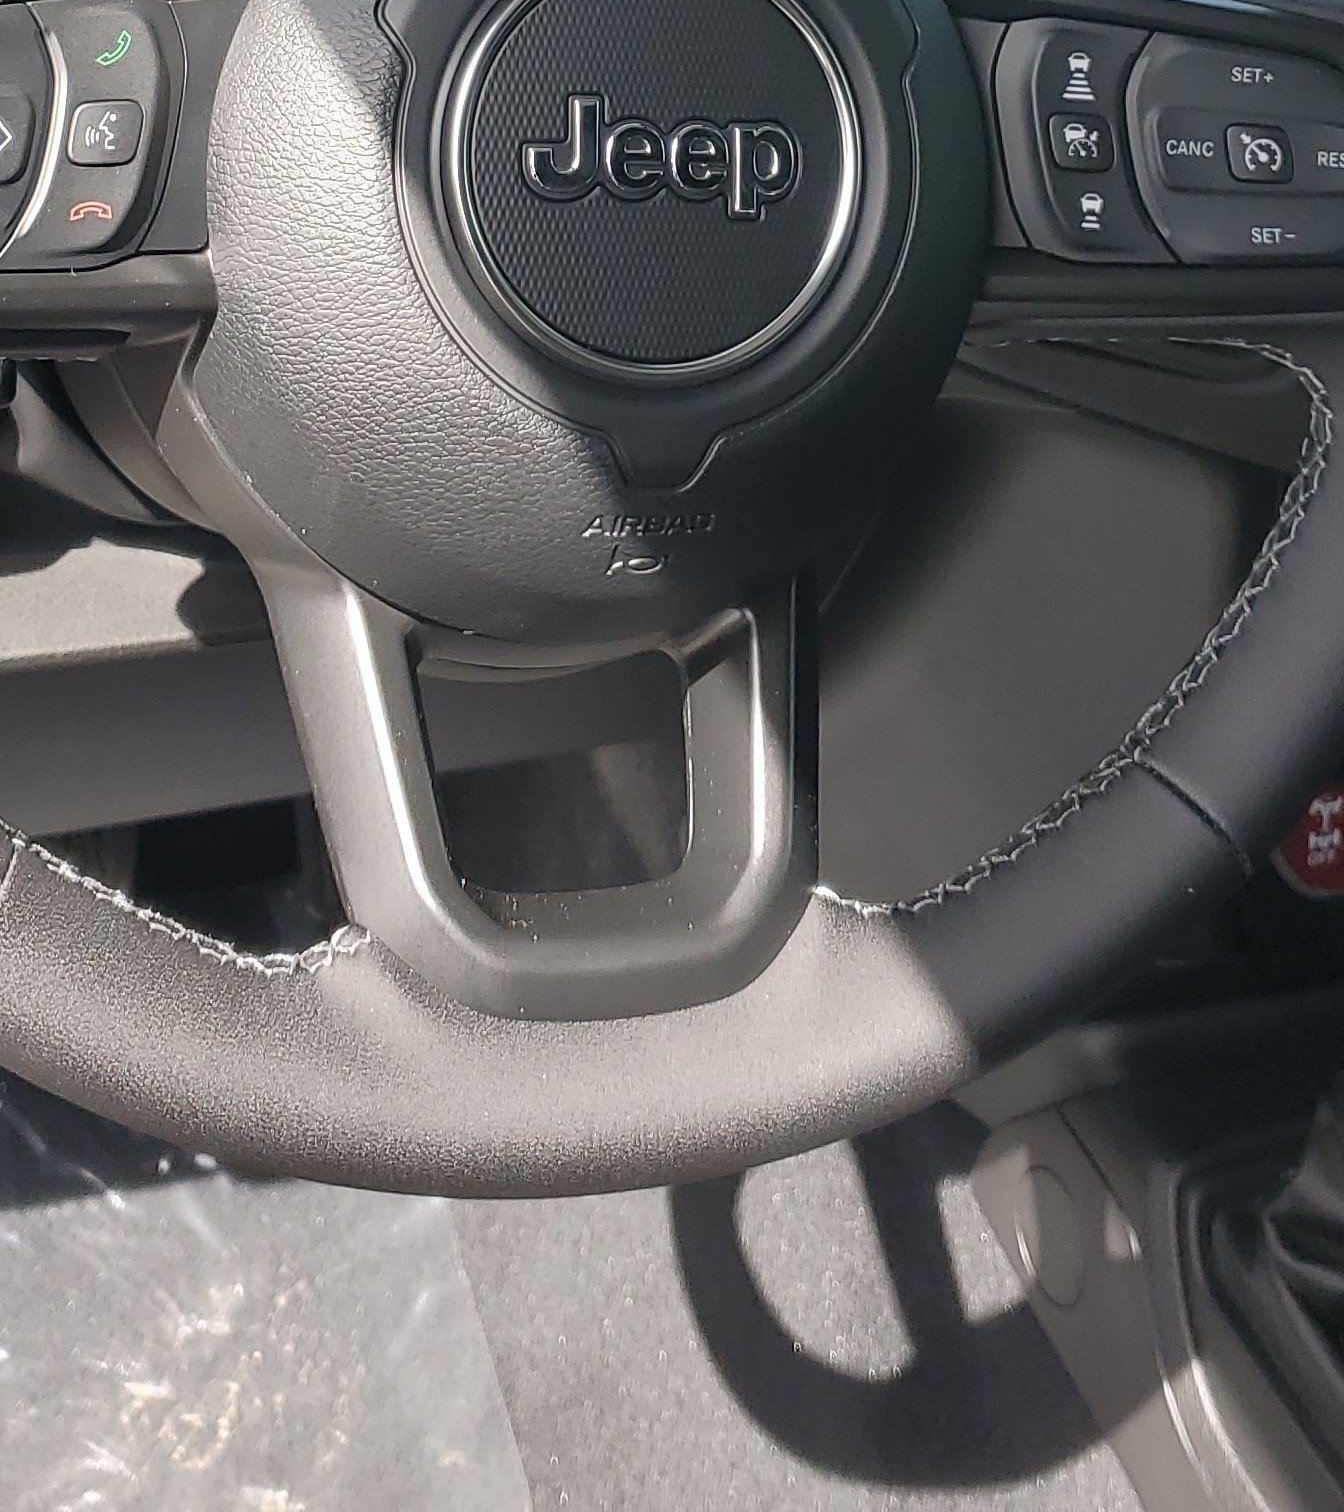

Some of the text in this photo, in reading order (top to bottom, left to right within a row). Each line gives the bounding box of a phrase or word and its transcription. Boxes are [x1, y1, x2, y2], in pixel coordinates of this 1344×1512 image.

[1230, 65, 1274, 83] SET+
[521, 91, 802, 221] Jeep
[1164, 139, 1214, 157] CANC
